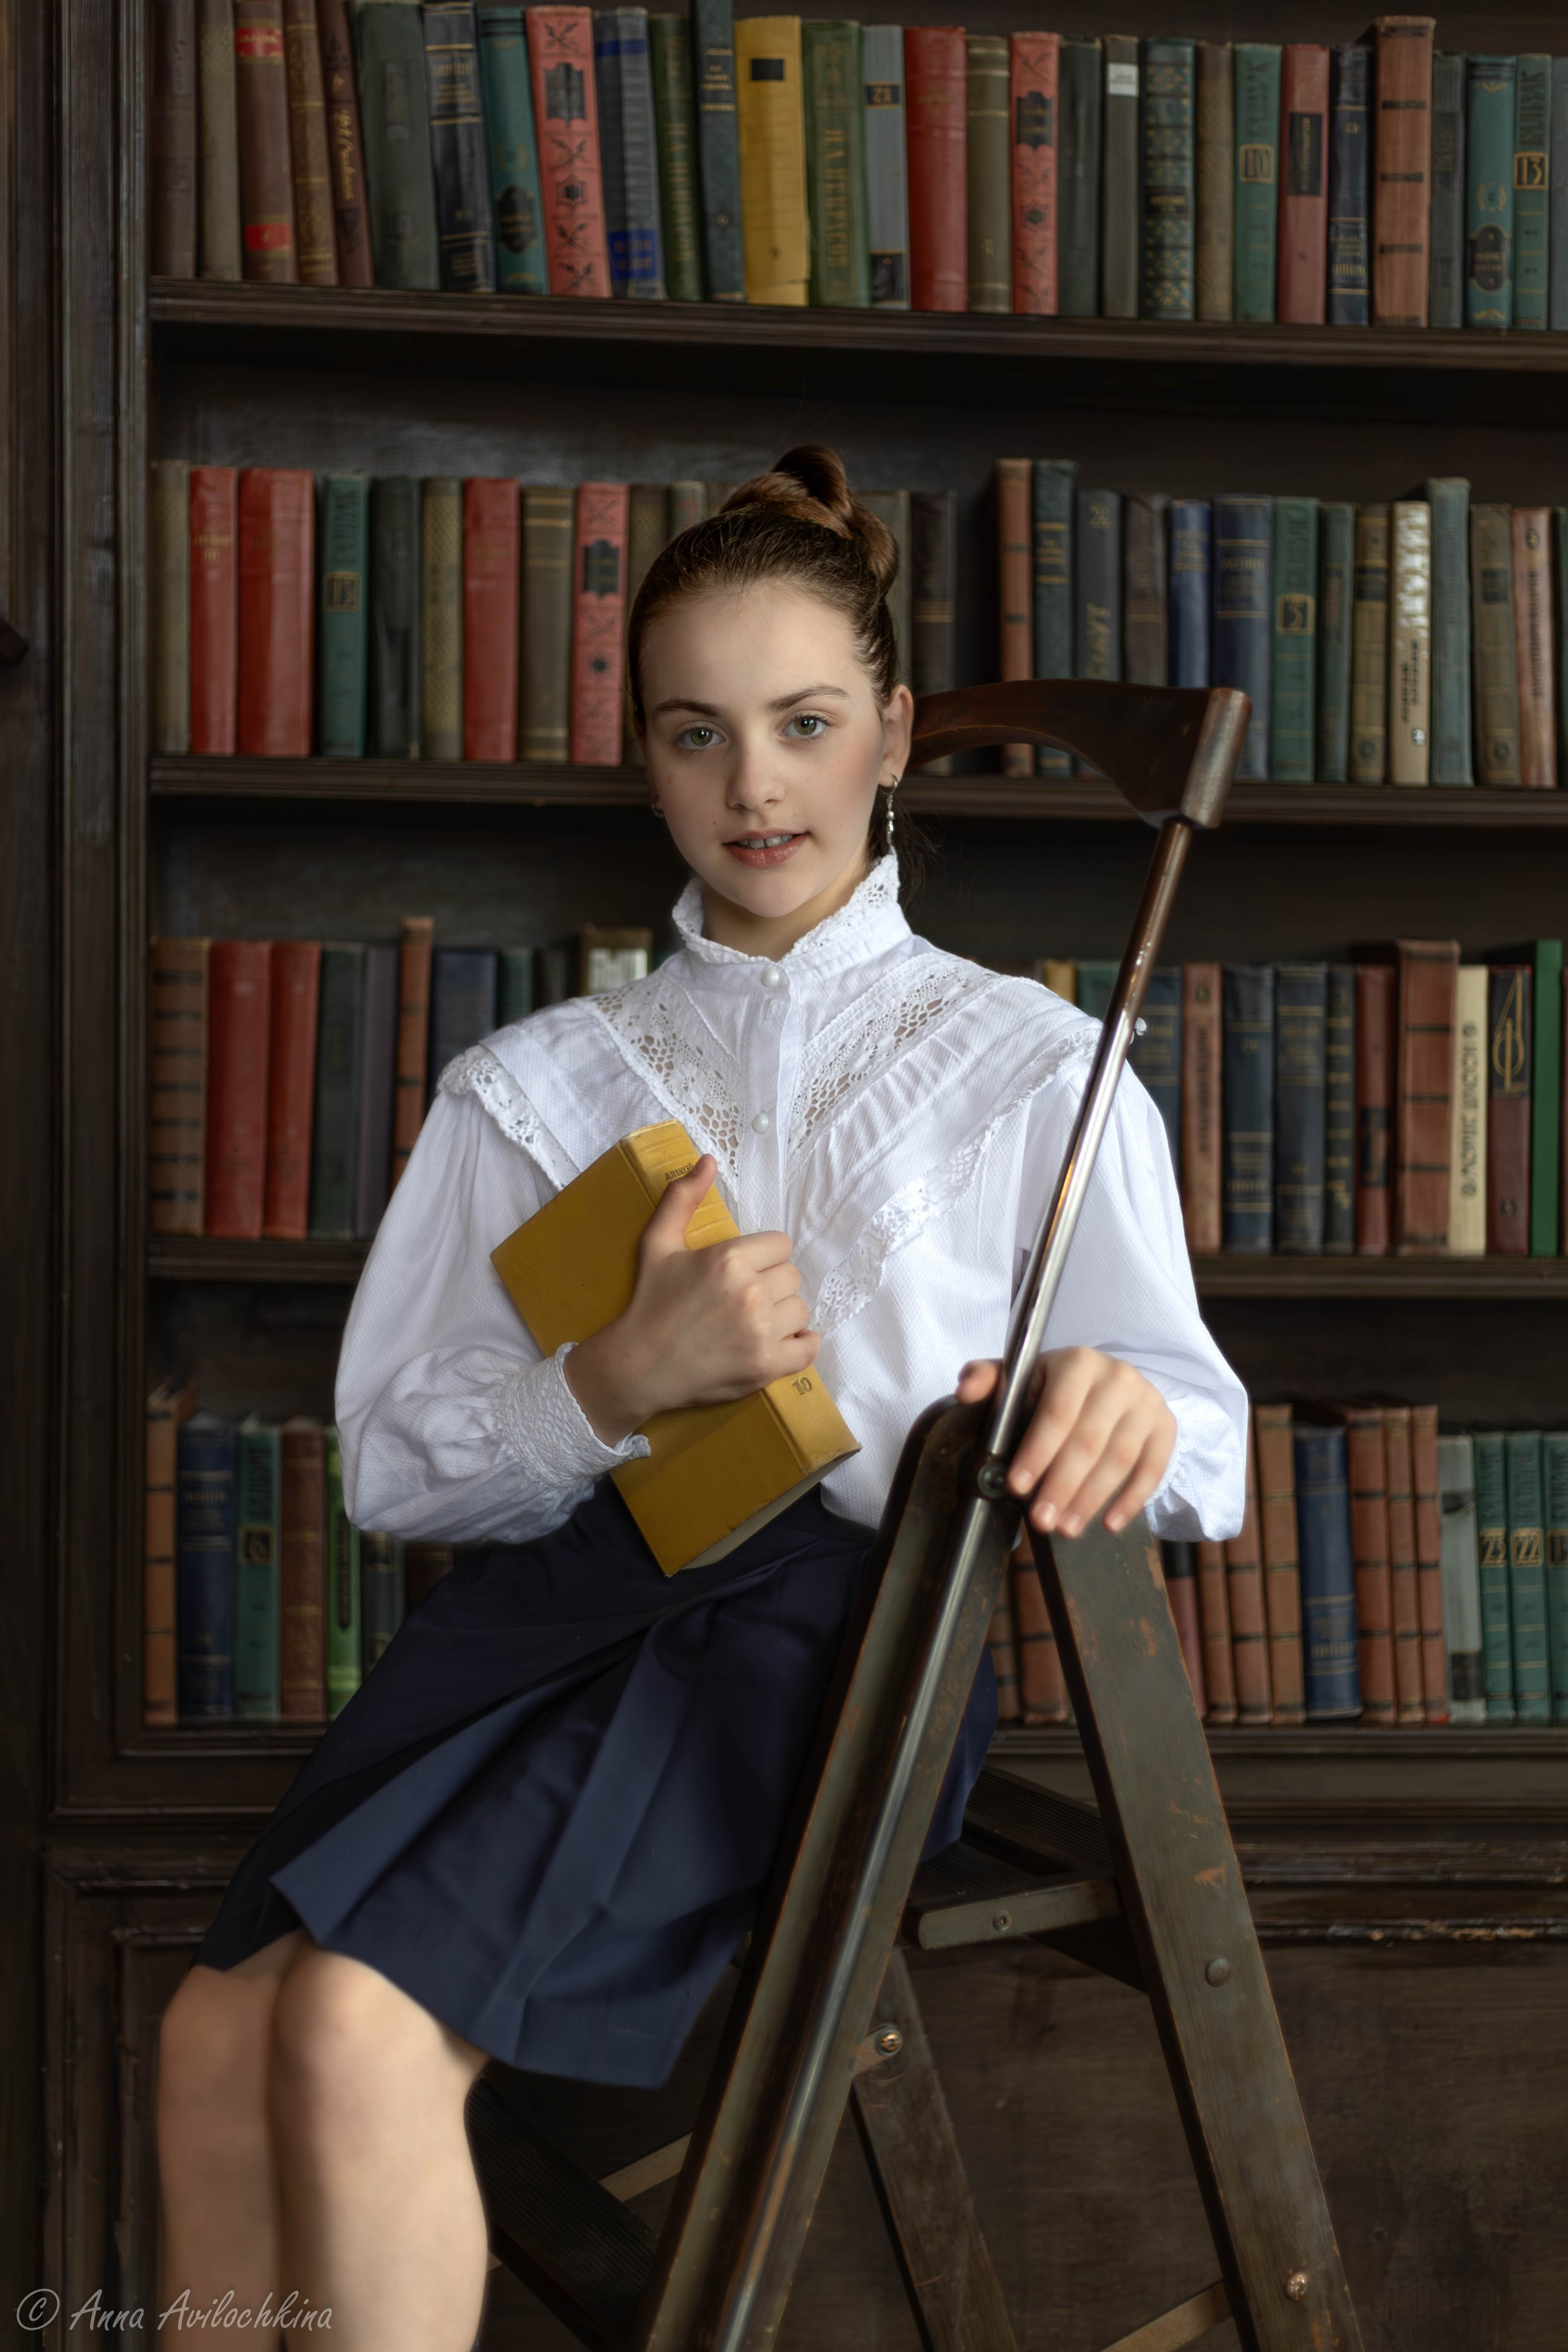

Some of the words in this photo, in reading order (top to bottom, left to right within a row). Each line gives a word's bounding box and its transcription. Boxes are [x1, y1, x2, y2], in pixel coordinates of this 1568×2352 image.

[1521, 156, 1543, 186] 13
[791, 1376, 813, 1395] 10
[1515, 1534, 1540, 1564] 22
